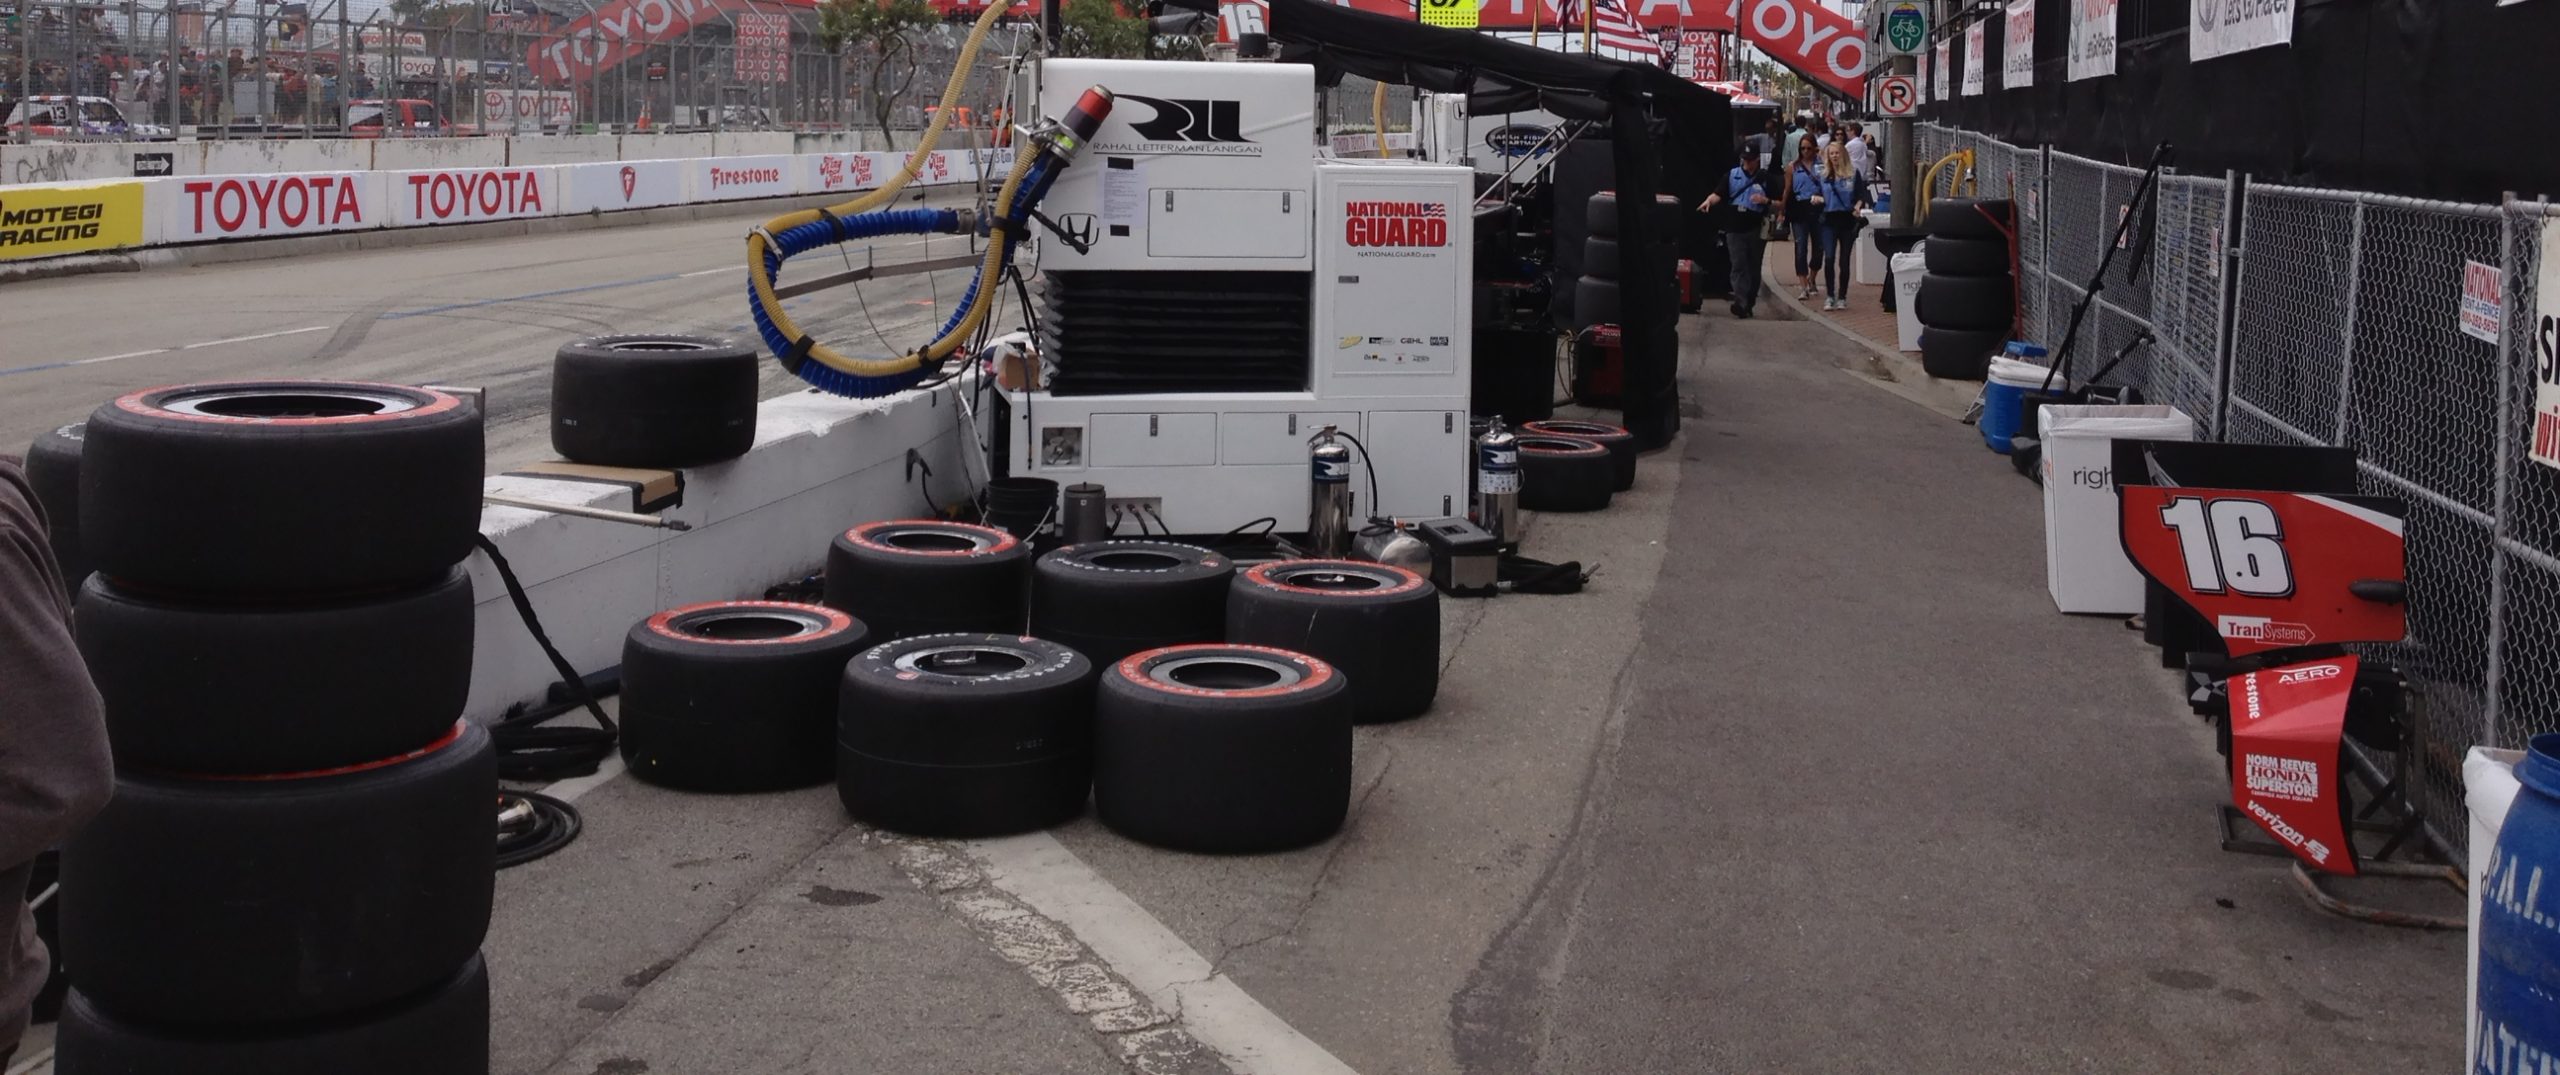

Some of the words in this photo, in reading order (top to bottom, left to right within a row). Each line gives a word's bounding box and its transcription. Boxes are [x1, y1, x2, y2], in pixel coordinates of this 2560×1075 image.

[1219, 3, 1265, 41] 16
[1900, 37, 1912, 50] 17
[51, 106, 66, 120] 13
[1093, 142, 1133, 152] RAHAL
[1137, 142, 1204, 153] LETTERMAN
[1206, 143, 1263, 154] LANIGAN
[710, 167, 779, 191] Firestone
[184, 177, 361, 234] TOYOTA
[408, 171, 542, 220] TOYOTA
[2, 203, 103, 227] MOTEGI
[1346, 202, 1424, 217] NATIONAL
[0, 223, 99, 247] RACING
[1346, 217, 1447, 247] GUARD
[2463, 263, 2501, 306] NATIONAL
[2160, 497, 2295, 597] 16
[2278, 667, 2341, 684] AERO
[2246, 672, 2261, 719] restone
[2246, 754, 2279, 769] NORM
[2280, 758, 2317, 773] REEVES
[2251, 767, 2312, 784] HONDA
[2246, 777, 2319, 798] SUPERSTORE
[2247, 800, 2304, 846] verizon
